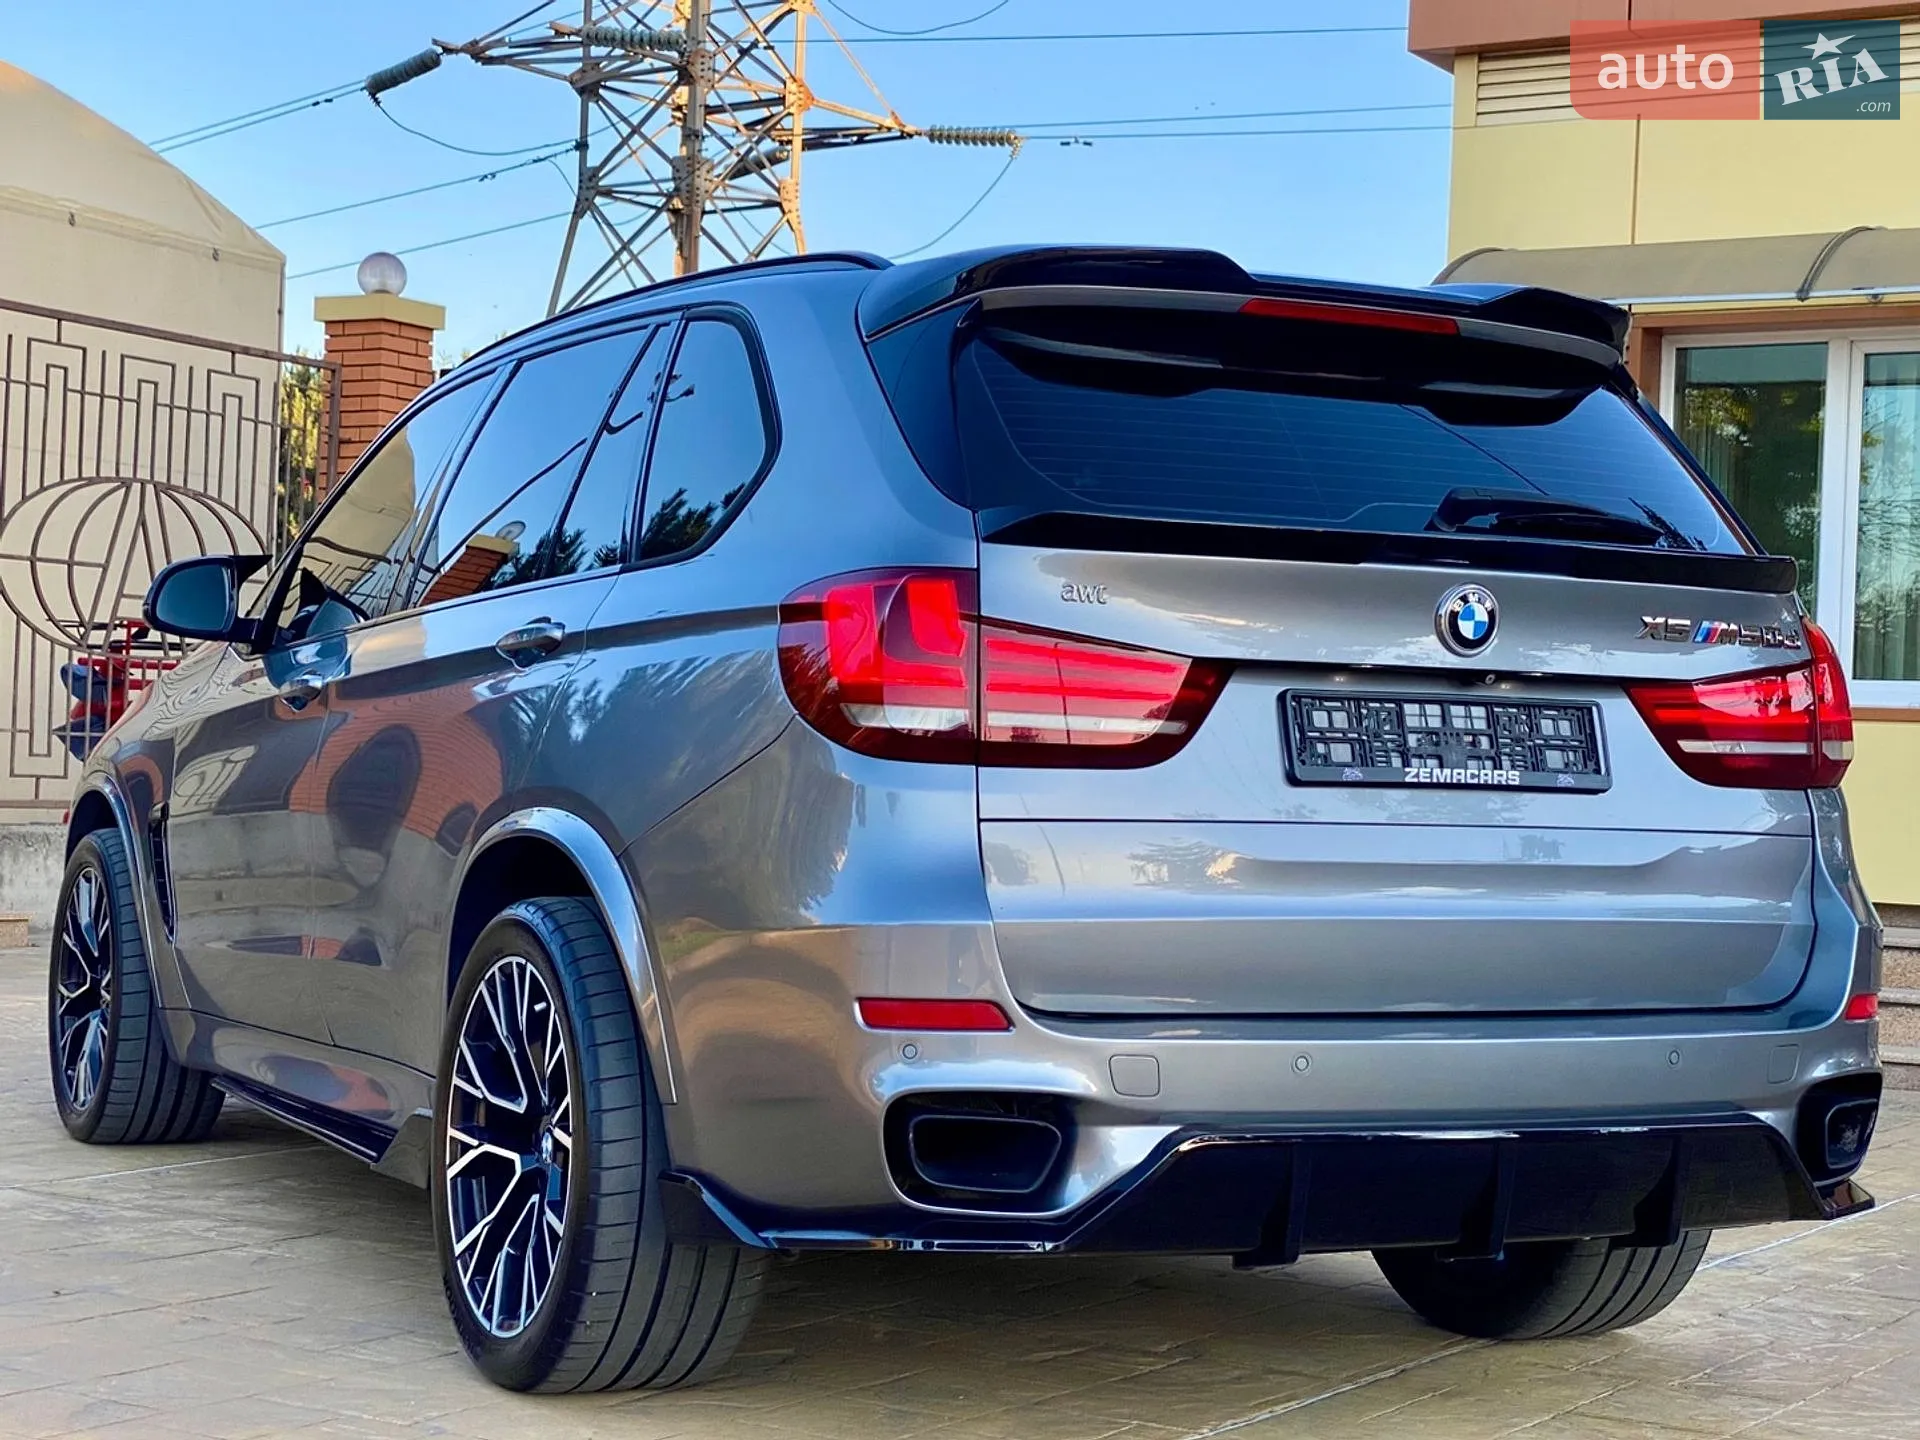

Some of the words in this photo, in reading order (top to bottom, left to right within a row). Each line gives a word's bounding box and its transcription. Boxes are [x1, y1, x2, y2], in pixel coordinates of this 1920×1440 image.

[1451, 592, 1495, 612] BMW
[1635, 615, 1691, 642] X5
[1404, 767, 1521, 785] ZEMACARS
